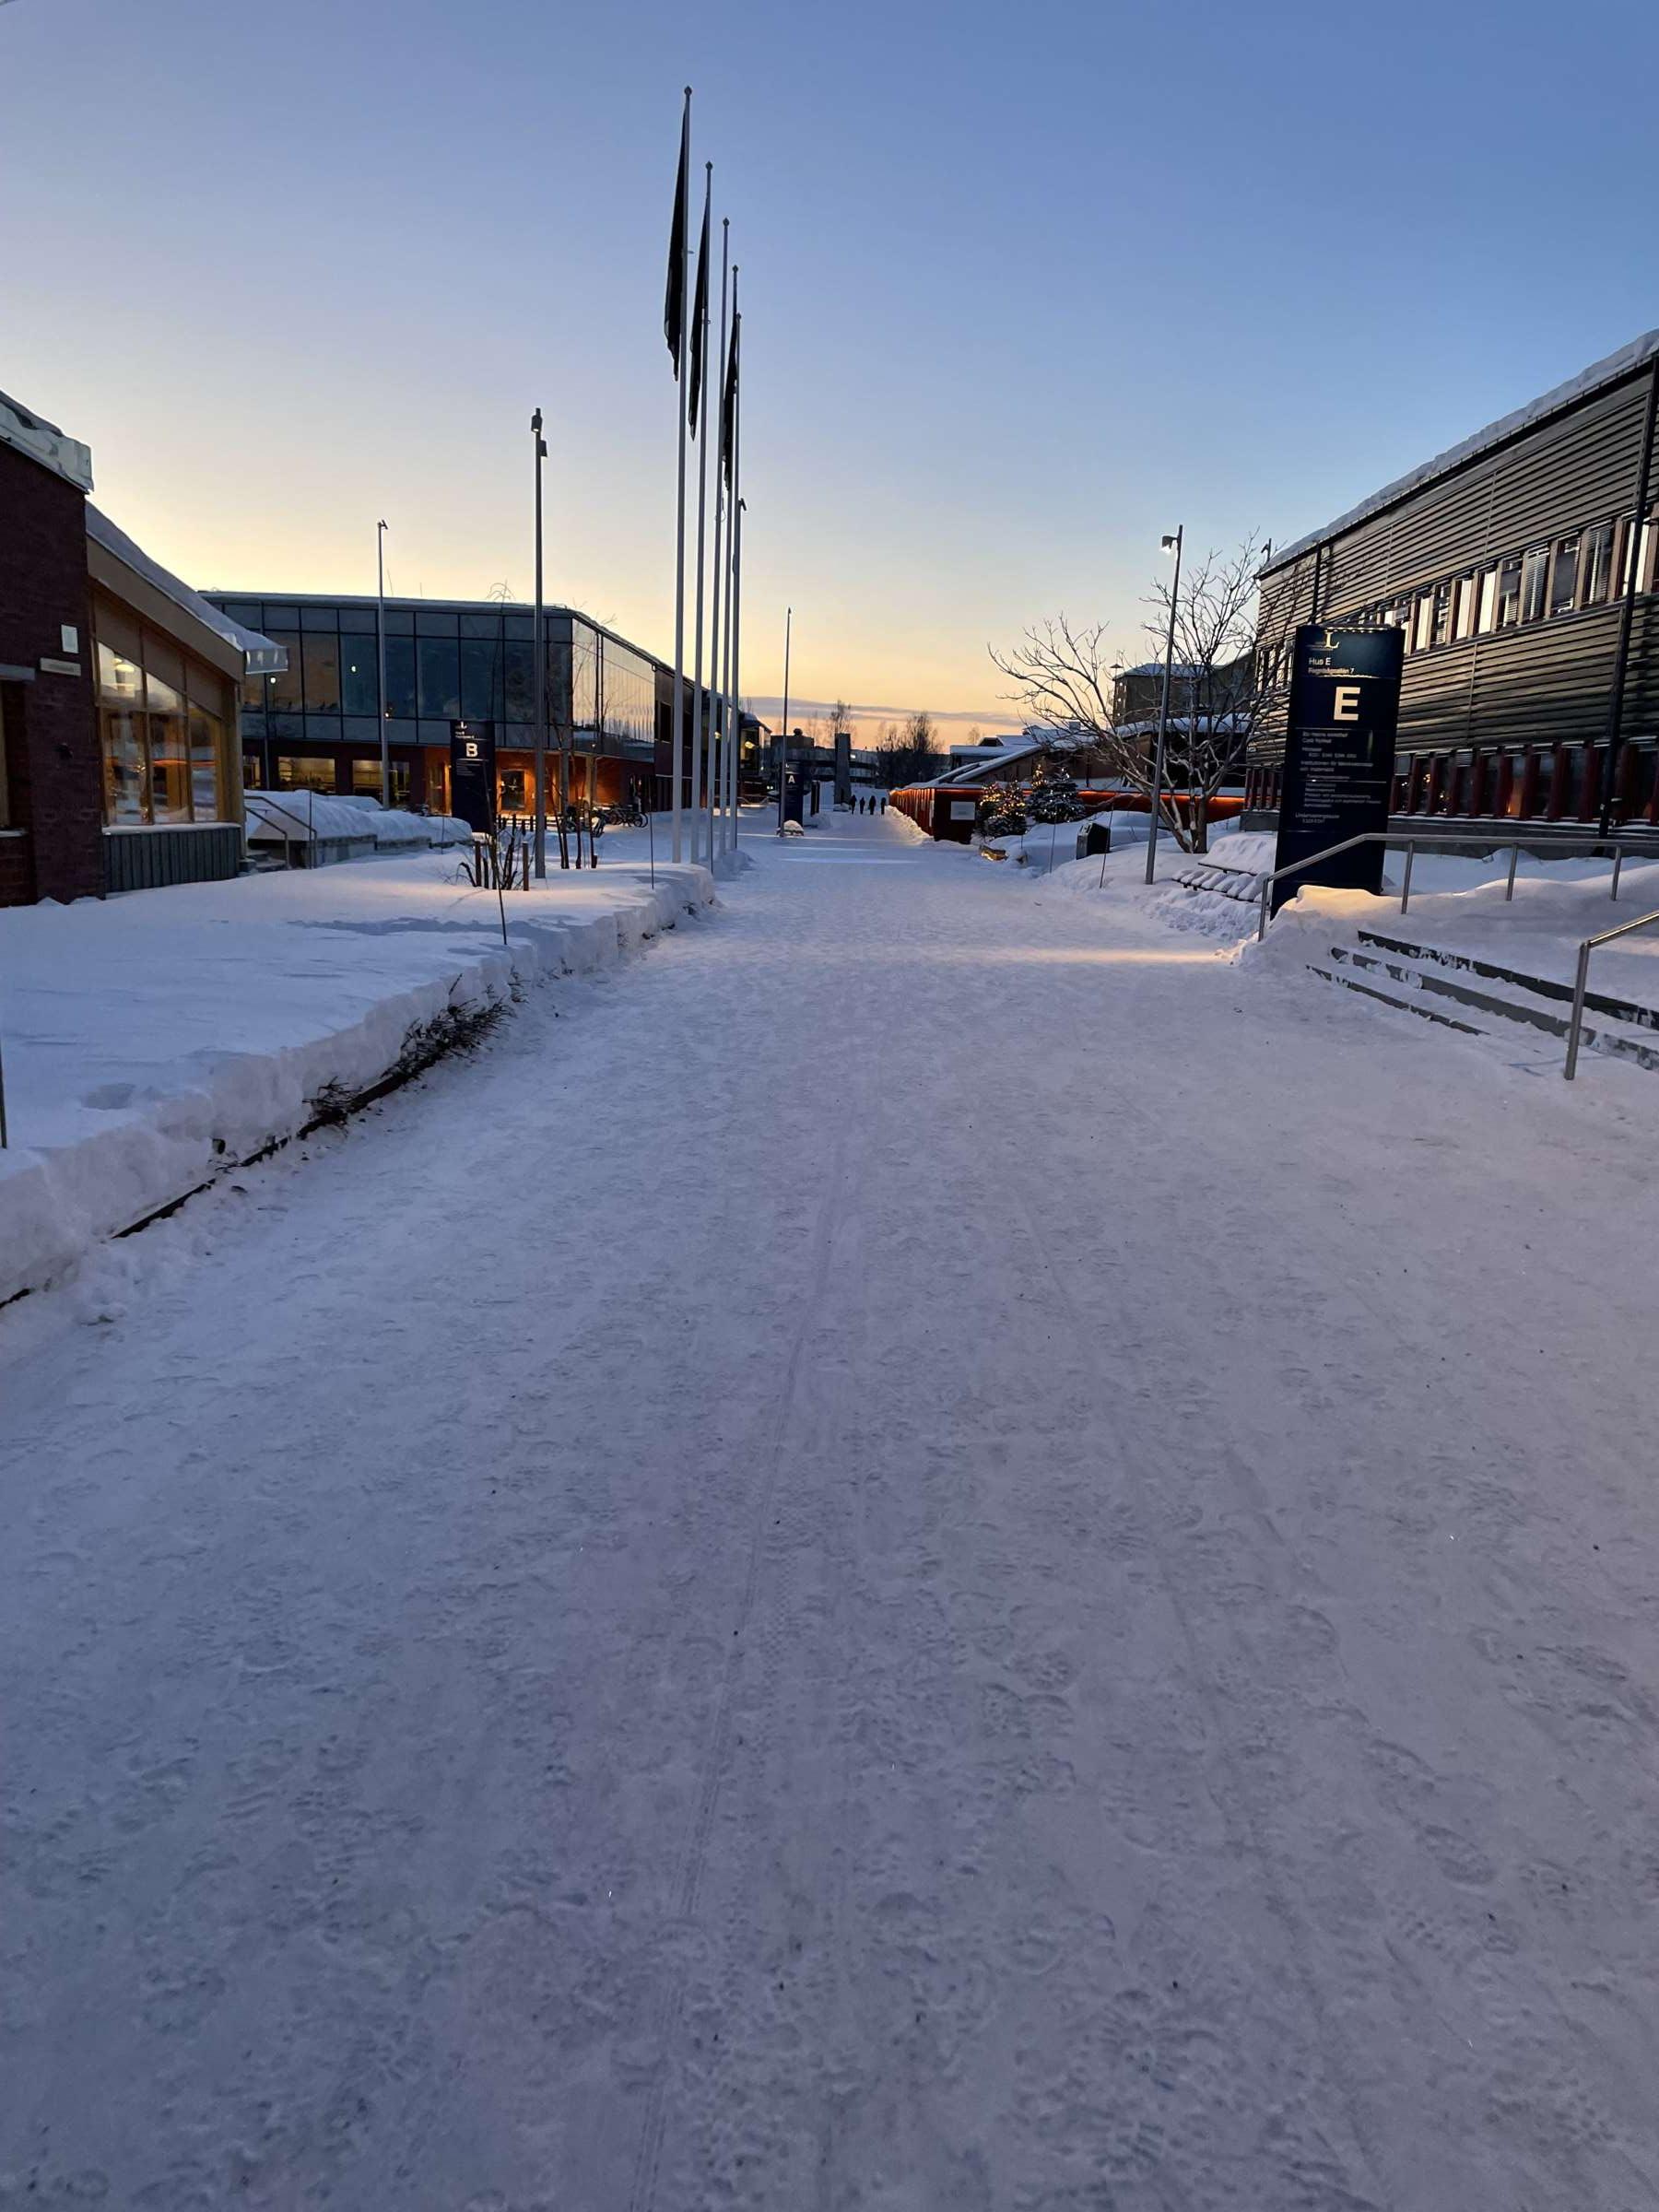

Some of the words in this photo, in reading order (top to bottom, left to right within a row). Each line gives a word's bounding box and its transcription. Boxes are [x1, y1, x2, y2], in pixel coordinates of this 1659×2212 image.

[1325, 657, 1332, 665] E
[1334, 686, 1361, 721] E
[465, 742, 478, 758] B
[788, 774, 796, 784] A
